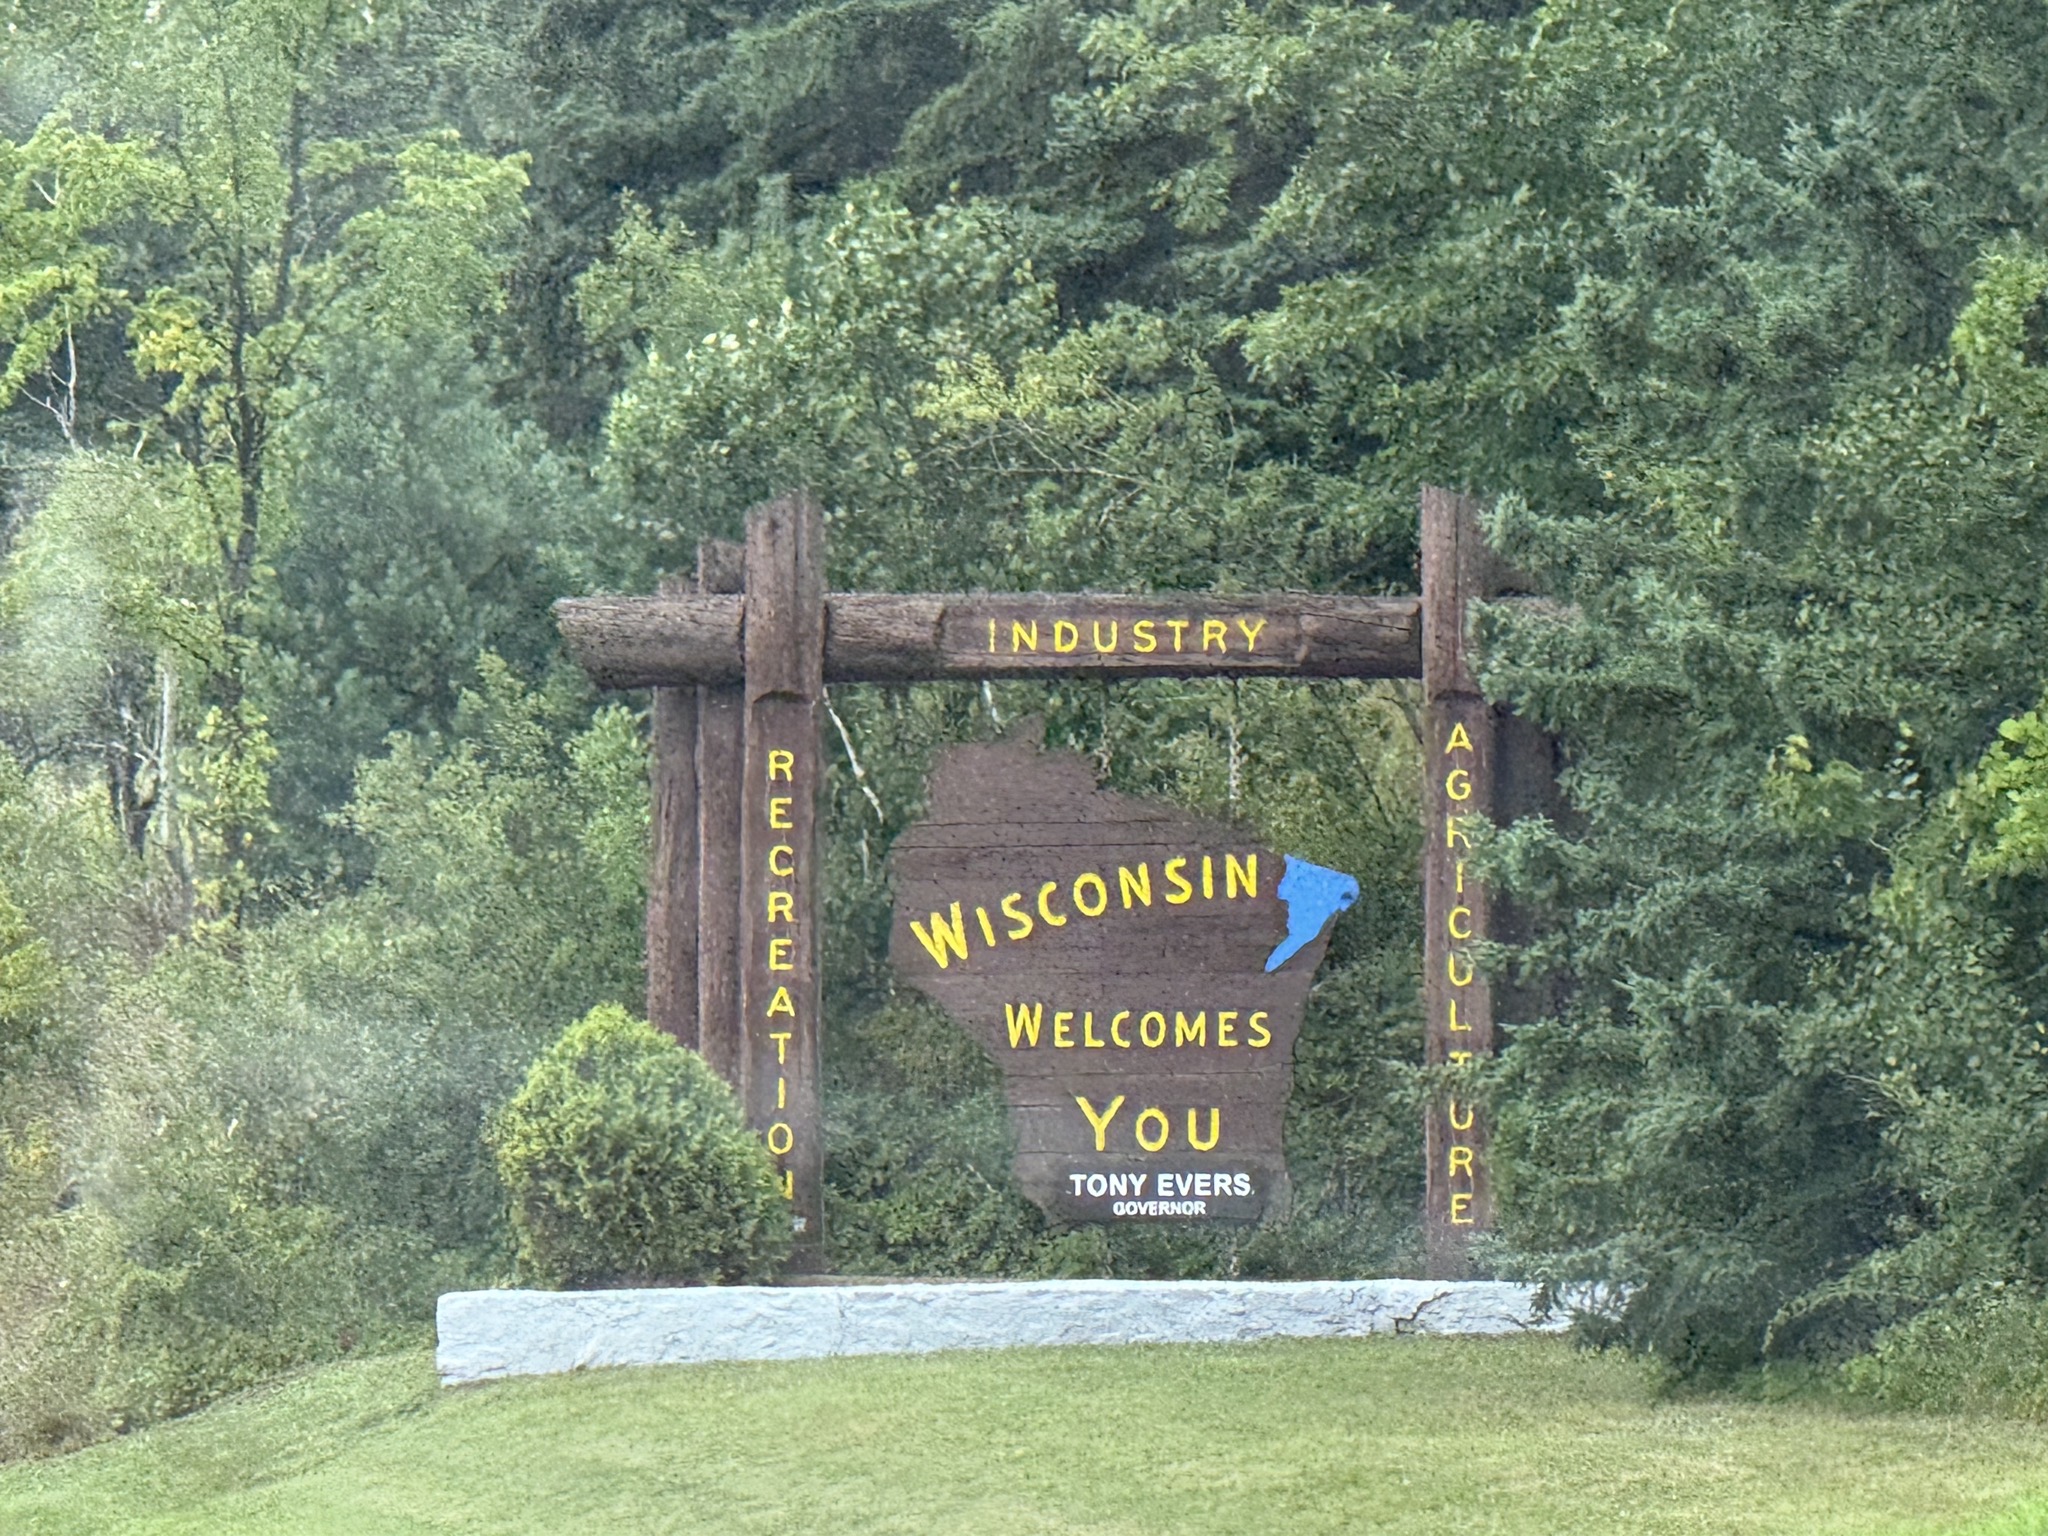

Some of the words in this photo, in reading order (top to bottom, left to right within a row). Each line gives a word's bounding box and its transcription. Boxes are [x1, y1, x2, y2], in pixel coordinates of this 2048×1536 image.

[988, 618, 1268, 654] INDUSTRY
[910, 853, 1258, 969] WISCONSIN
[1005, 1002, 1272, 1049] WELCOMES
[1074, 1095, 1221, 1152] YOU
[1069, 1173, 1148, 1198] TONY
[1157, 1173, 1252, 1197] EVERS
[1112, 1200, 1207, 1217] GOVERNOR
